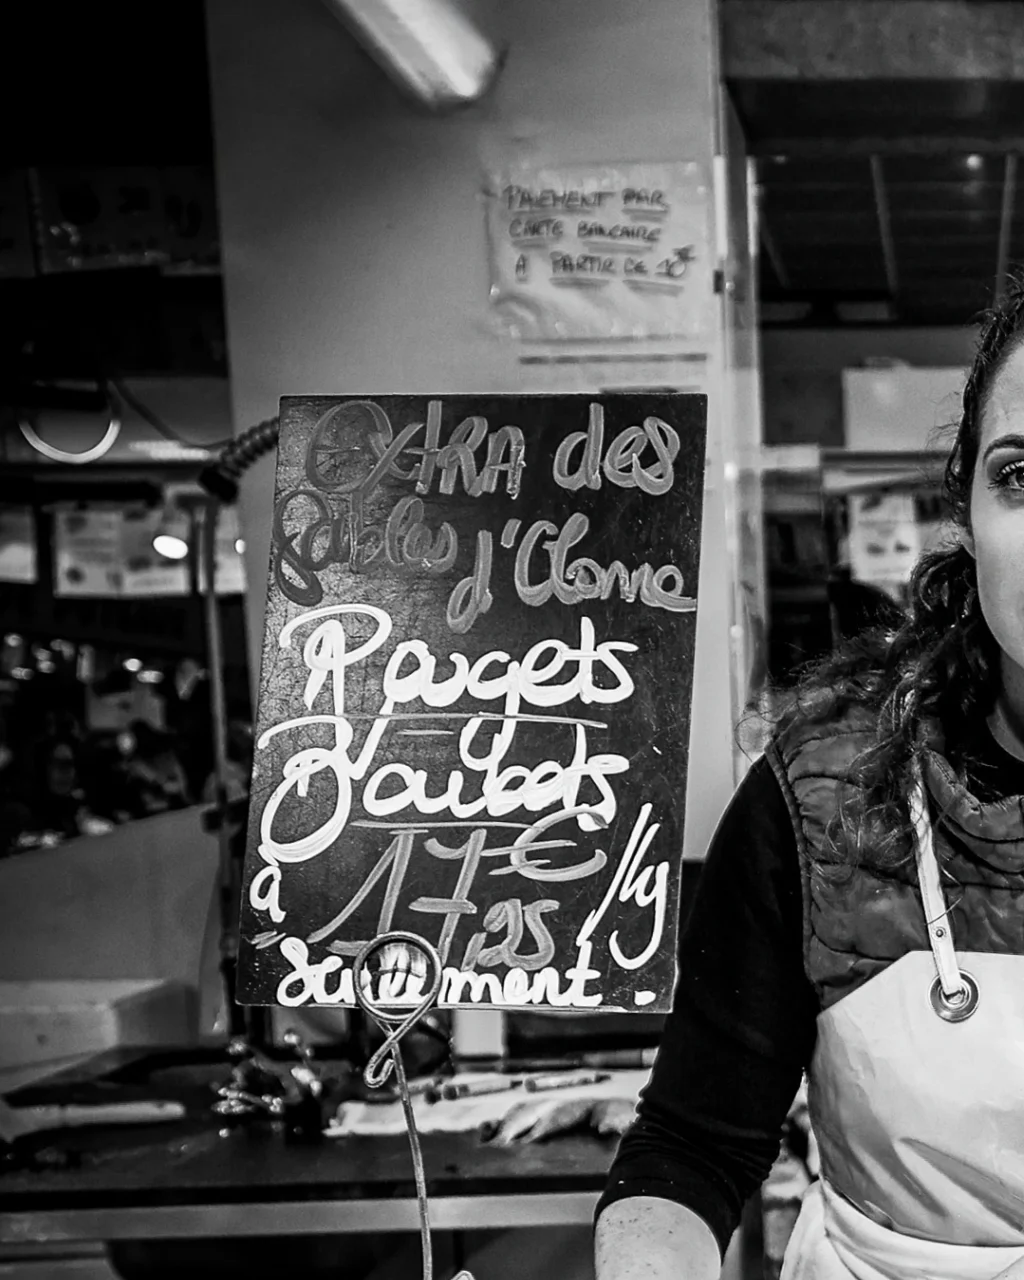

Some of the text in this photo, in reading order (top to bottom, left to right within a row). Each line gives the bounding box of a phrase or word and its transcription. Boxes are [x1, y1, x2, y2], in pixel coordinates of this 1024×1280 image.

[550, 251, 616, 275] PARTIR
[552, 402, 680, 496] des
[280, 603, 639, 768] Rougets
